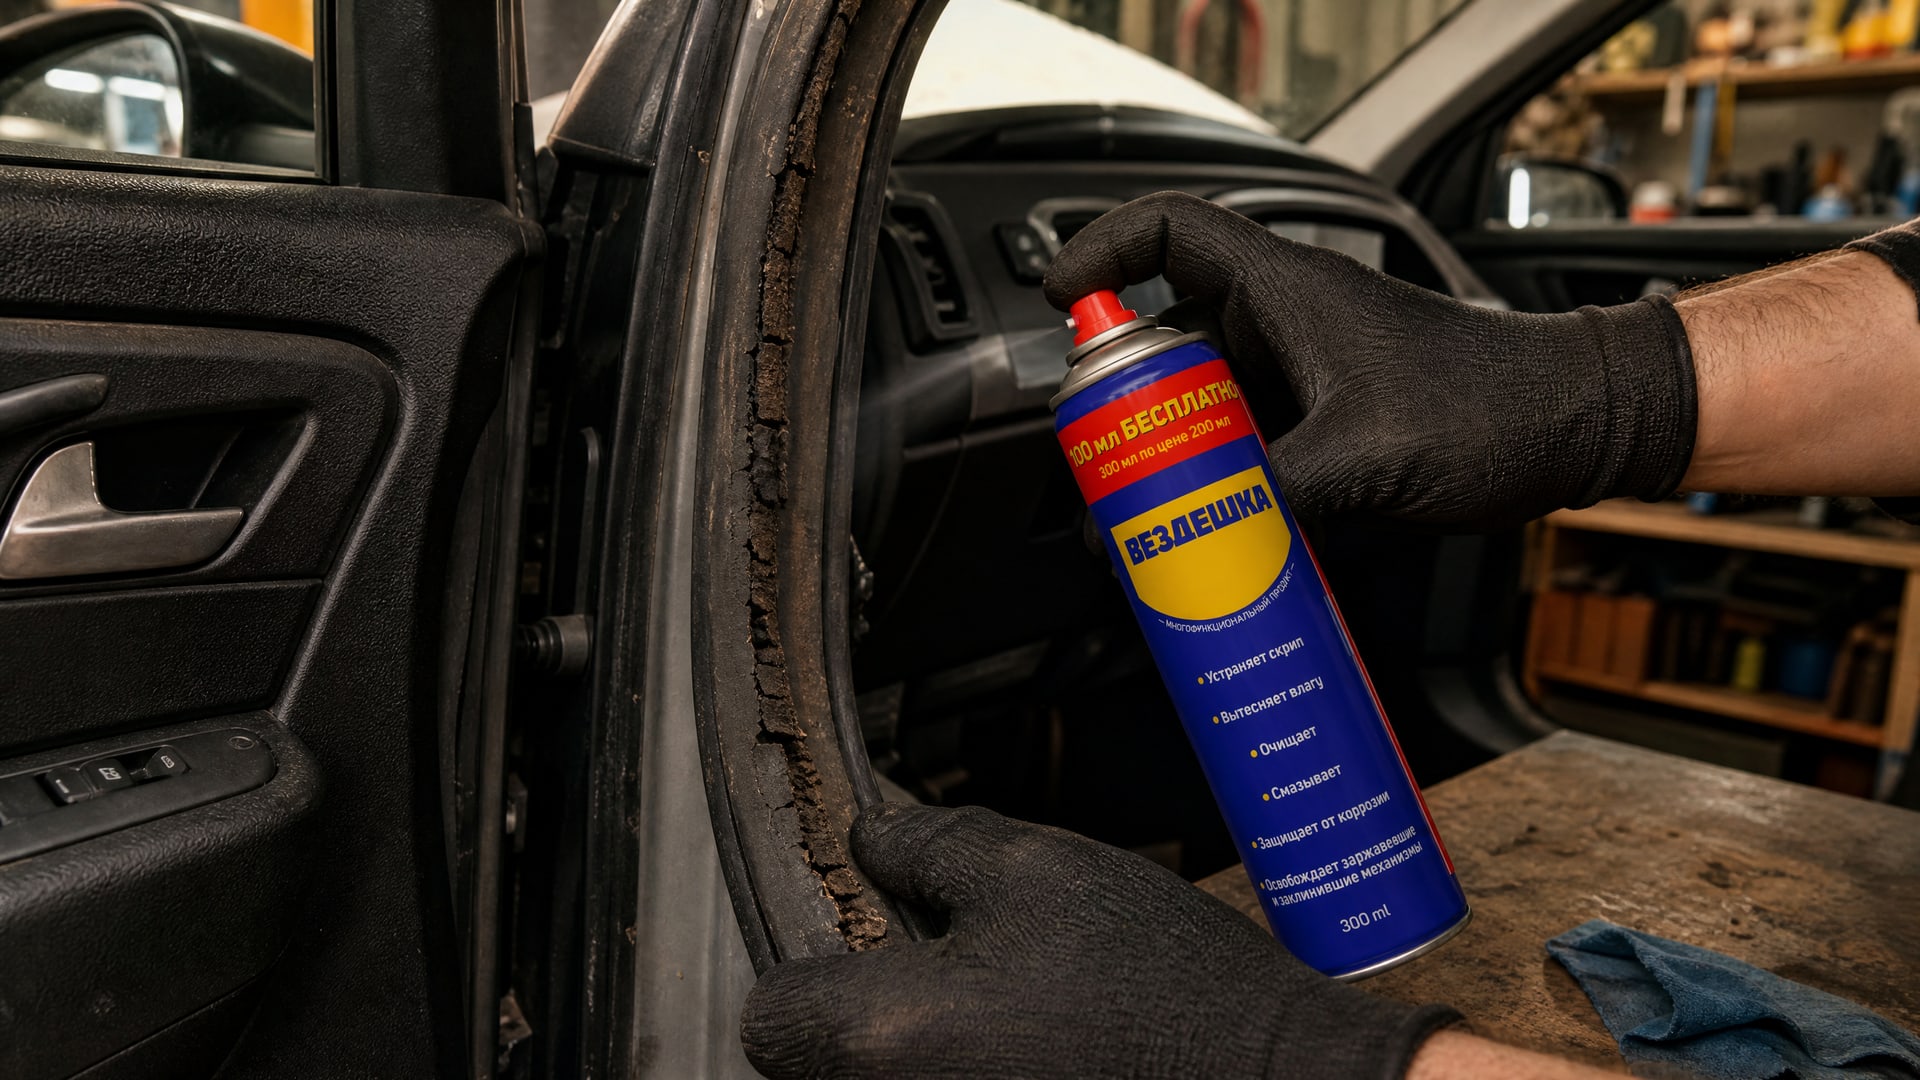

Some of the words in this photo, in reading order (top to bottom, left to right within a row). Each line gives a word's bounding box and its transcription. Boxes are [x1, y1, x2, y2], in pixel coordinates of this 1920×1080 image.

[1070, 440, 1094, 468] 100
[1097, 430, 1121, 455] мл
[1120, 379, 1239, 441] БЕСПЛАТНО
[1099, 461, 1120, 479] 300
[1121, 453, 1138, 469] мл
[1140, 447, 1155, 460] по
[1157, 432, 1189, 455] цене
[1189, 419, 1214, 439] 200
[1216, 415, 1231, 429] мл
[1124, 484, 1272, 566] ВЕЗДЕШКА
[1165, 596, 1272, 632] МНОГОФУНКЦИОНАЛЬНЫЙ
[1204, 653, 1267, 685] Устраняет
[1269, 637, 1305, 660] скрип
[1220, 693, 1287, 724] Вытесняет
[1289, 675, 1324, 698] влагу
[1259, 726, 1317, 756] Очищает
[1271, 764, 1342, 800] Смазывает
[1257, 822, 1319, 850] Защищает
[1321, 817, 1336, 830] от
[1338, 791, 1391, 821] коррозии
[1265, 862, 1339, 891] Освобождает
[1341, 824, 1416, 869] заржавевшие
[1272, 896, 1279, 907] и
[1278, 873, 1360, 907] заклинившие
[1361, 841, 1423, 878] механизмы
[1340, 912, 1370, 933] 300
[1372, 904, 1391, 921] ml
